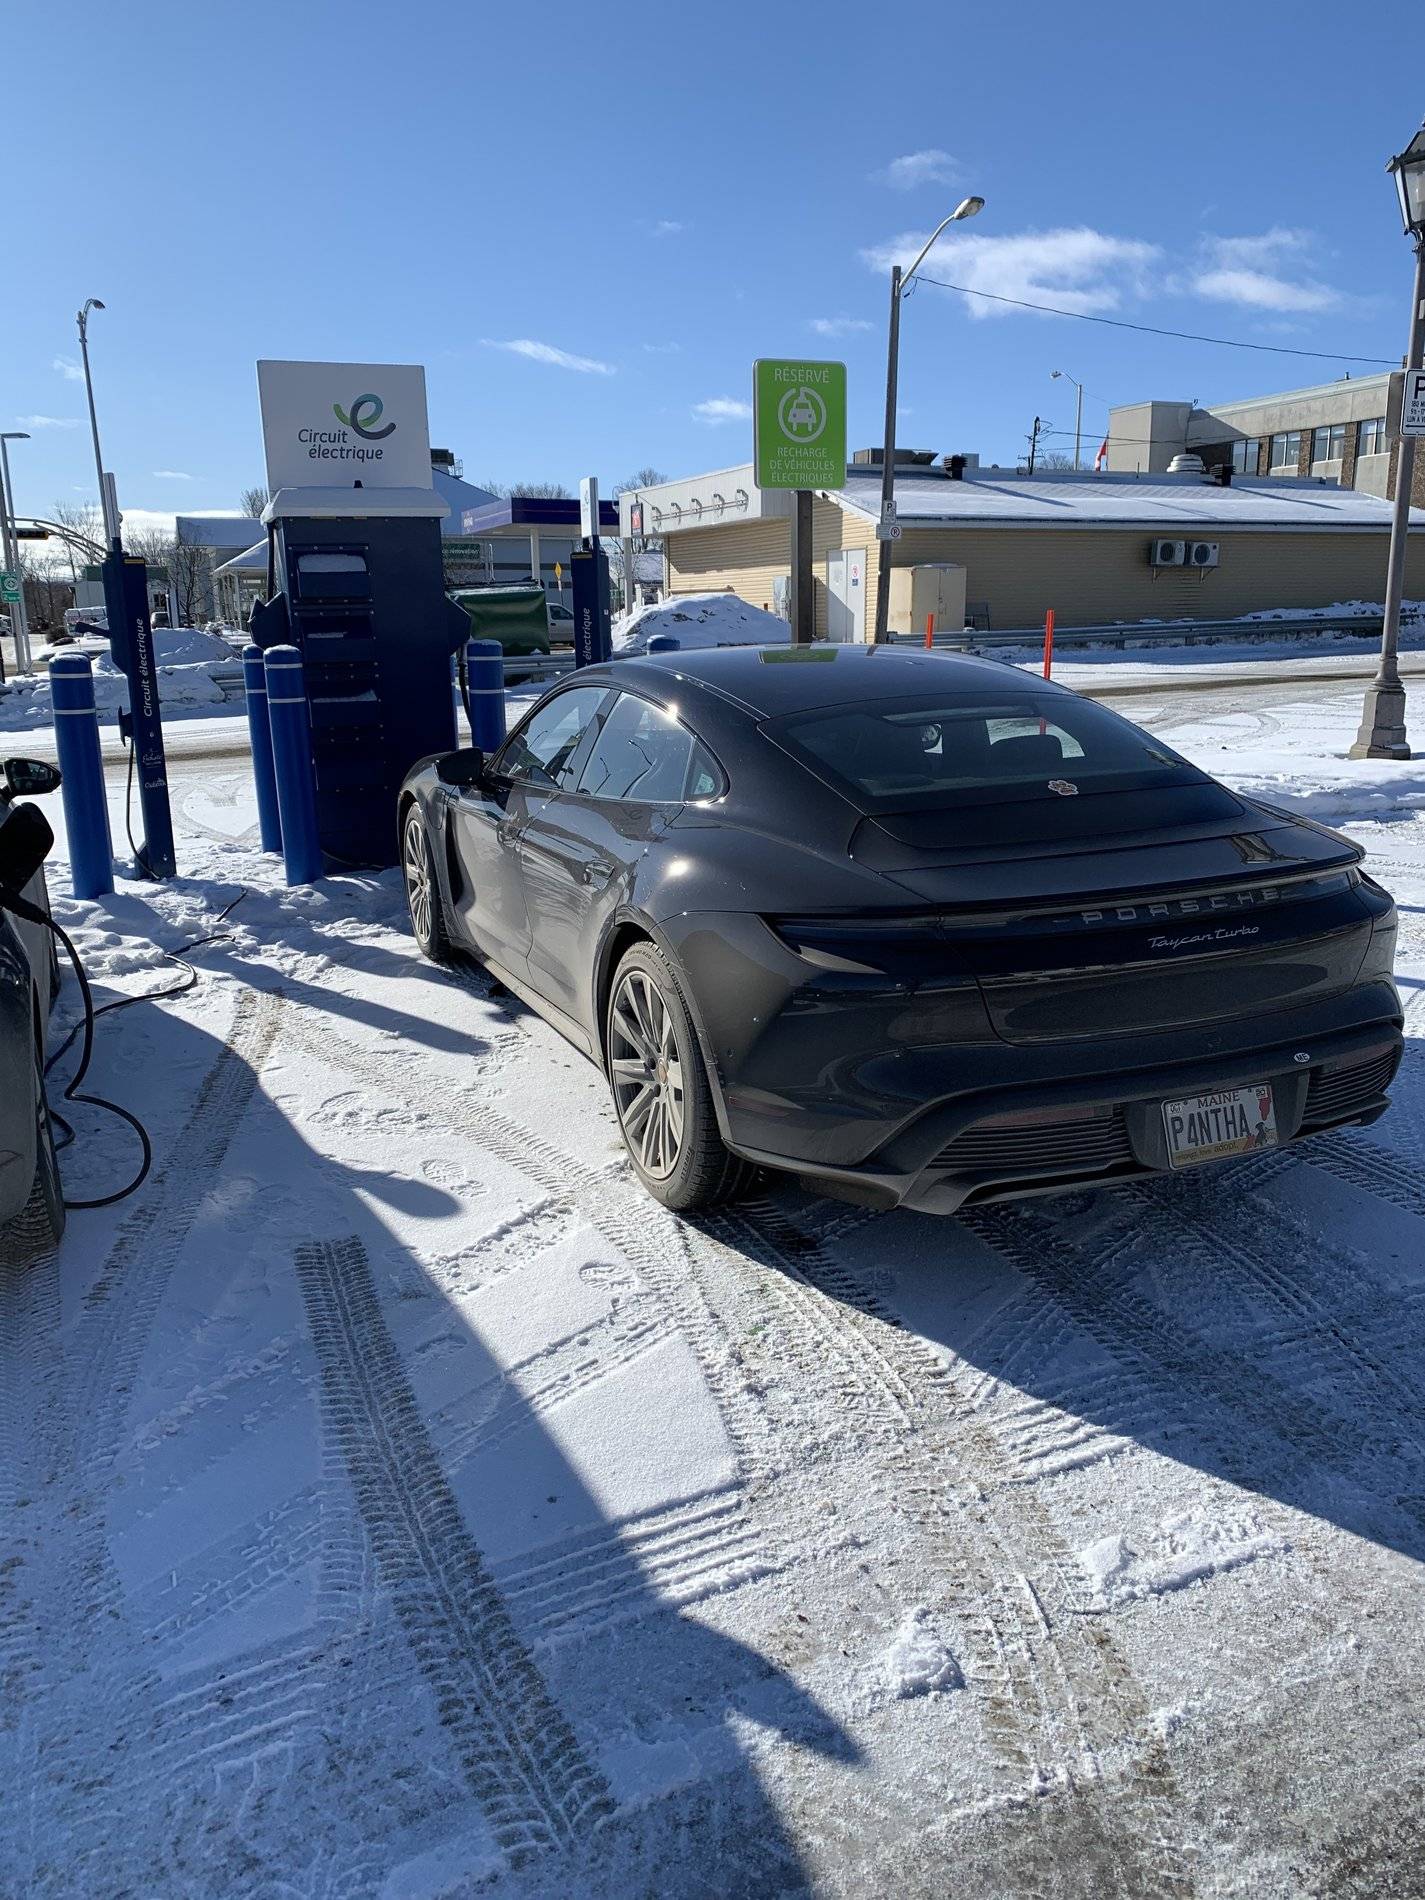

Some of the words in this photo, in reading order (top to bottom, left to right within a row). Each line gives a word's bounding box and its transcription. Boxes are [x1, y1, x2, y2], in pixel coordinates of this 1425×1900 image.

[774, 366, 830, 383] RÉSERVÉ
[298, 429, 348, 443] Circuit
[309, 444, 383, 462] électrique
[777, 447, 827, 458] RECHARGE
[769, 459, 782, 470] DE
[784, 457, 835, 470] VÉHICULES
[771, 470, 834, 483] ÉLECTRIQUES
[582, 608, 592, 660] électrique
[136, 618, 149, 677] électrique
[141, 678, 153, 717] Circuit
[1081, 888, 1280, 924] PORSCHE
[1148, 933, 1213, 950] Taycan
[1197, 1090, 1240, 1109] MAINE
[1171, 1103, 1251, 1152] P4NTHA
